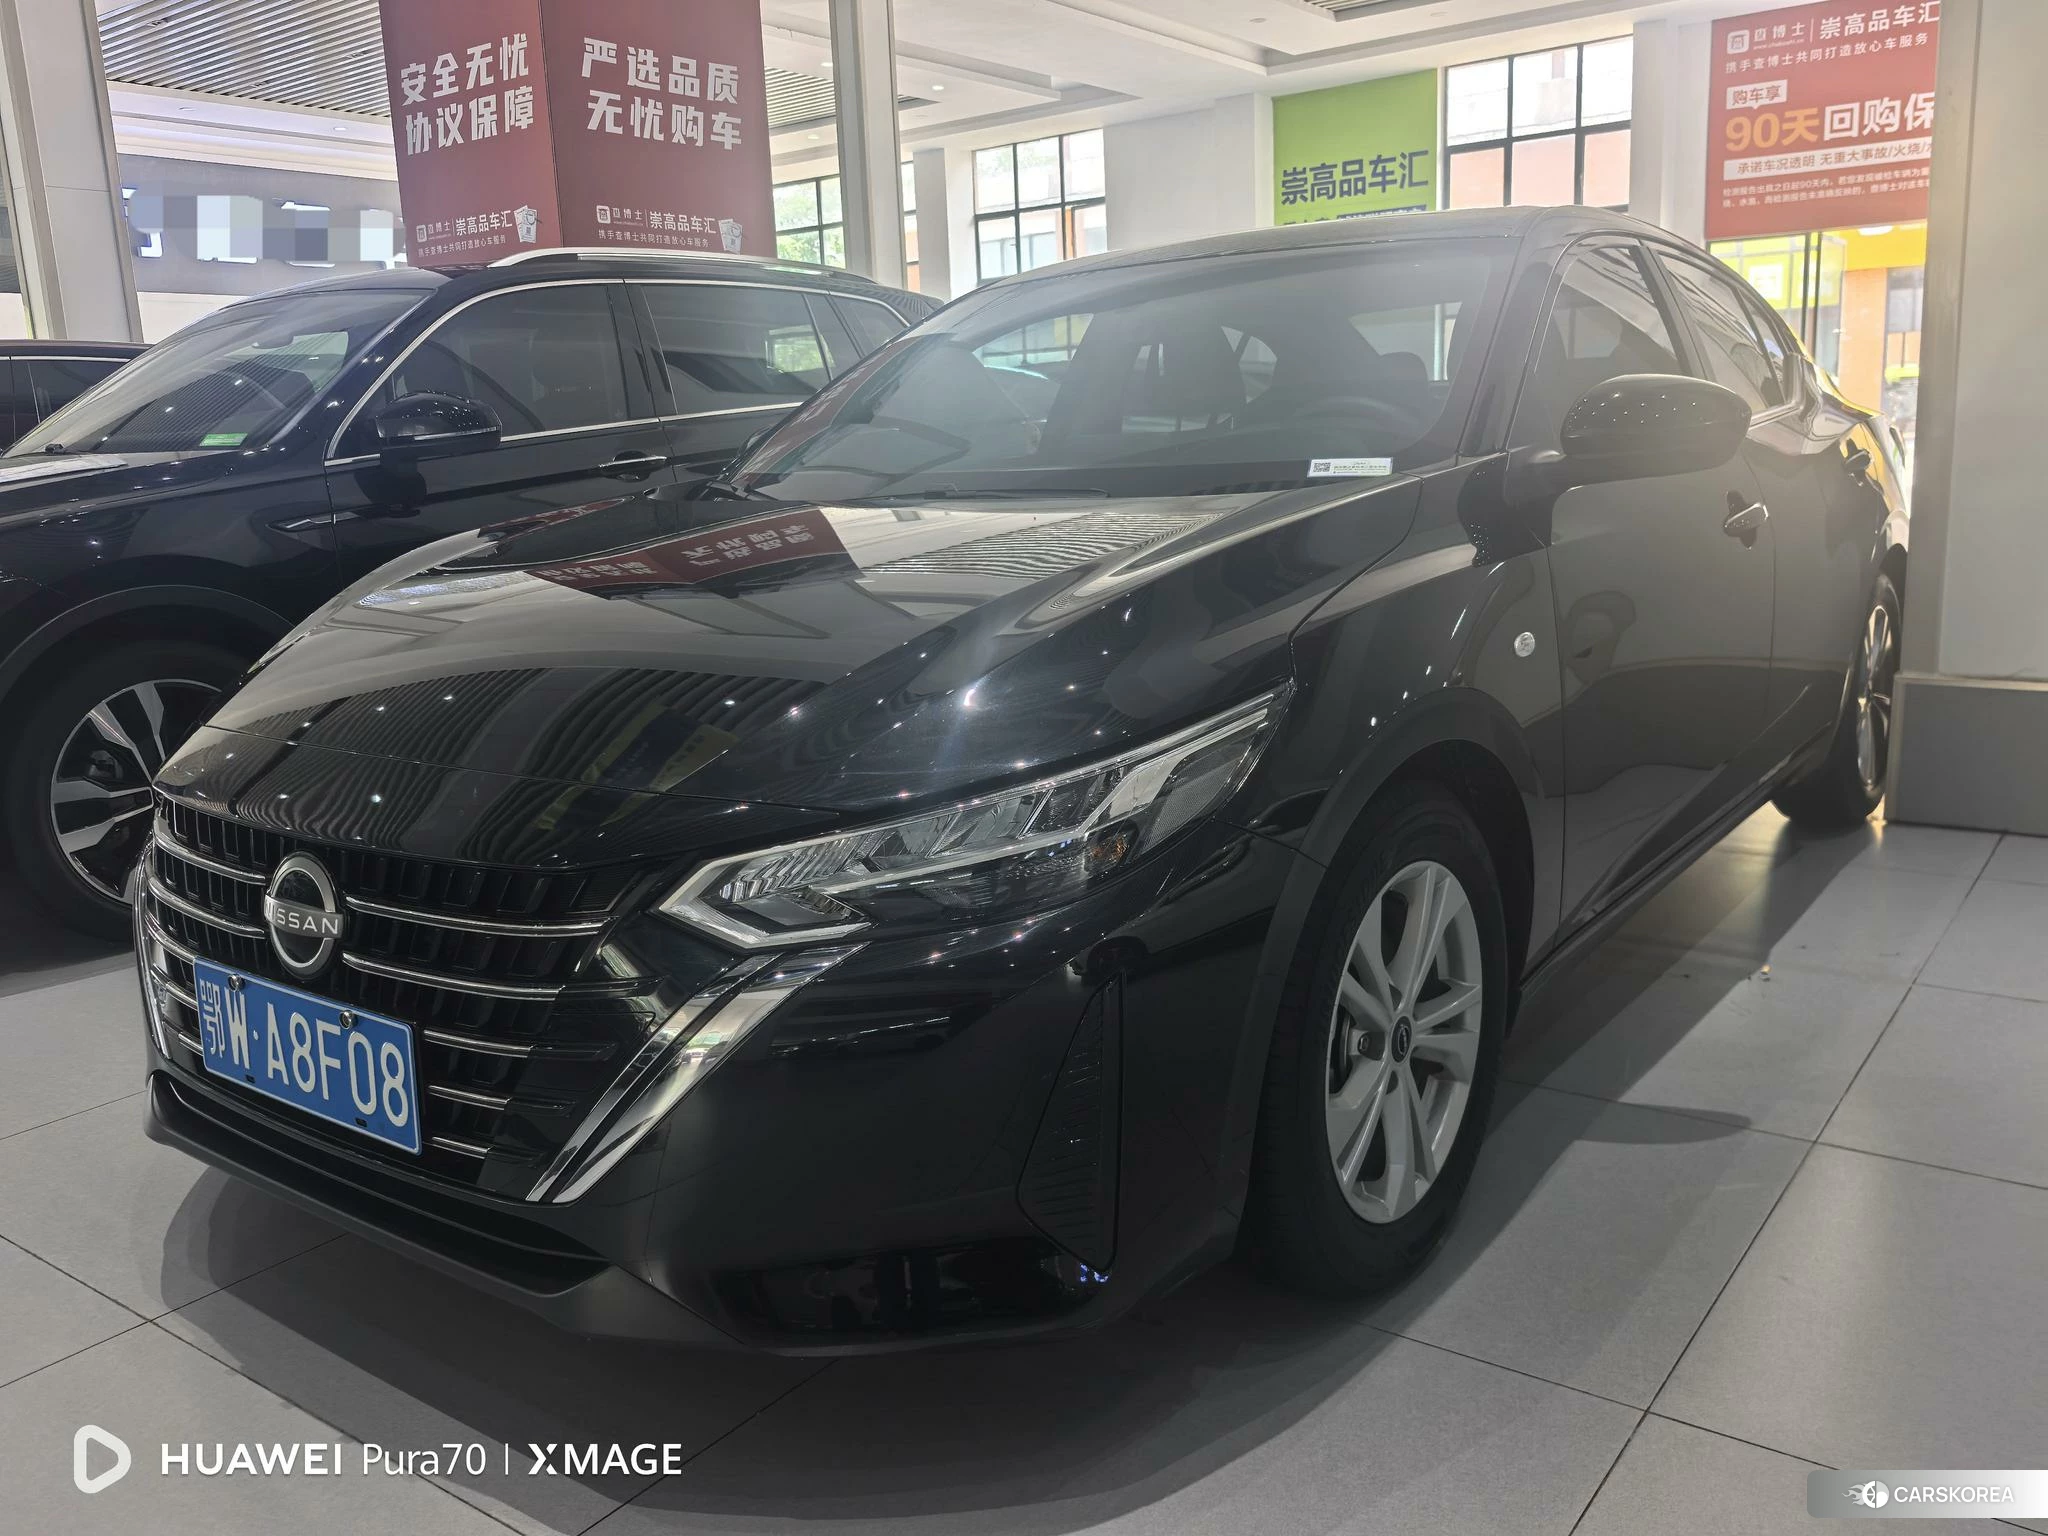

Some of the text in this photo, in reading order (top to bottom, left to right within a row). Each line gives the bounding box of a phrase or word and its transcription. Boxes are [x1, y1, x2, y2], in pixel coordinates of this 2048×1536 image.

[1819, 0, 1940, 41] 崇高品车汇
[401, 33, 529, 106] 安全无忧
[581, 37, 739, 104] 严选品质
[1731, 84, 1782, 106] 购车享
[405, 85, 534, 156] 协议保障
[586, 89, 743, 151] 无忧购车
[1281, 150, 1429, 206] 崇高品车汇
[455, 210, 512, 237] 崇高品车汇
[649, 211, 717, 234] 崇高品车汇
